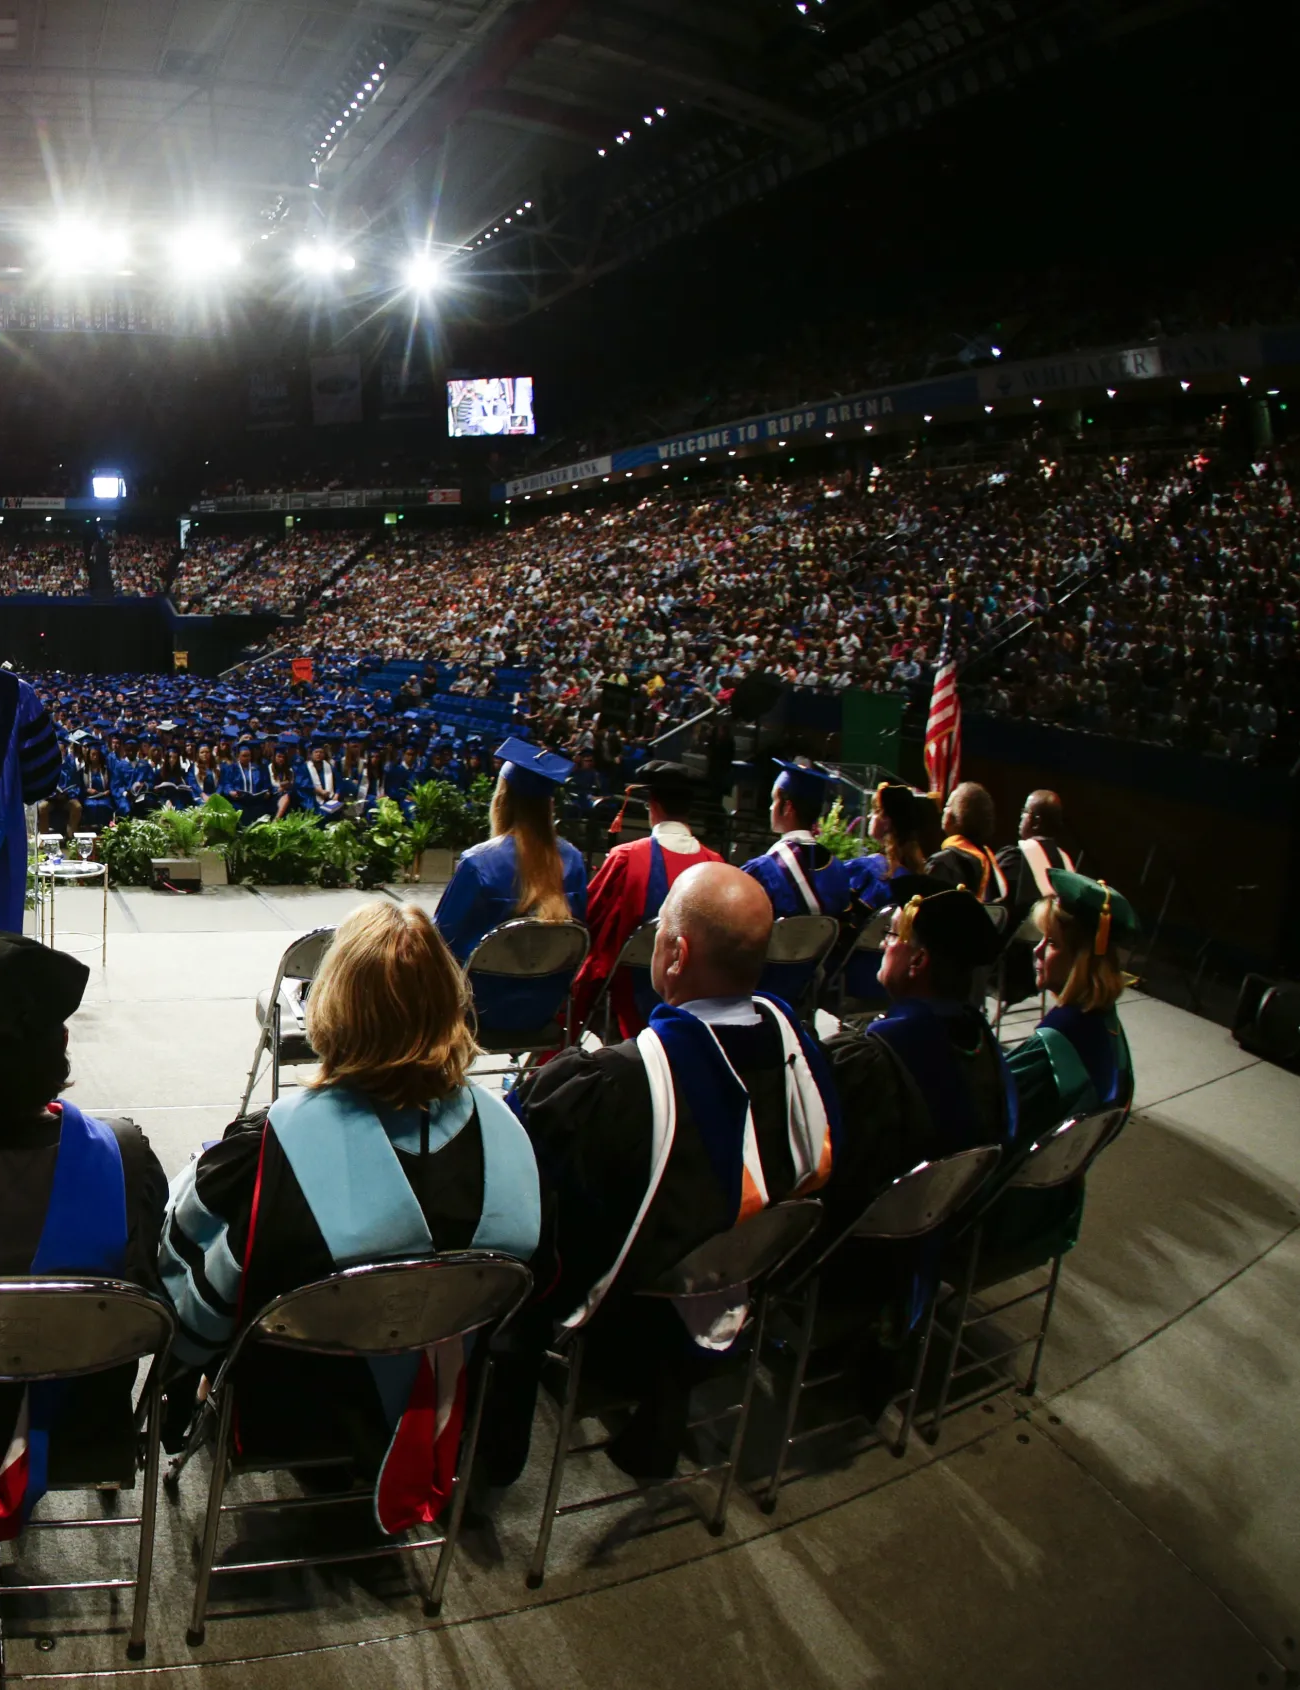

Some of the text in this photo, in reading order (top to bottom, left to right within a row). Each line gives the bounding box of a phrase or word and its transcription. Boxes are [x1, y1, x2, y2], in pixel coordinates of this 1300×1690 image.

[1022, 353, 1149, 388] WHITAKER
[657, 396, 894, 460] WELCOME TO RUPP ARENA
[522, 463, 599, 490] WHITAKER BANK
